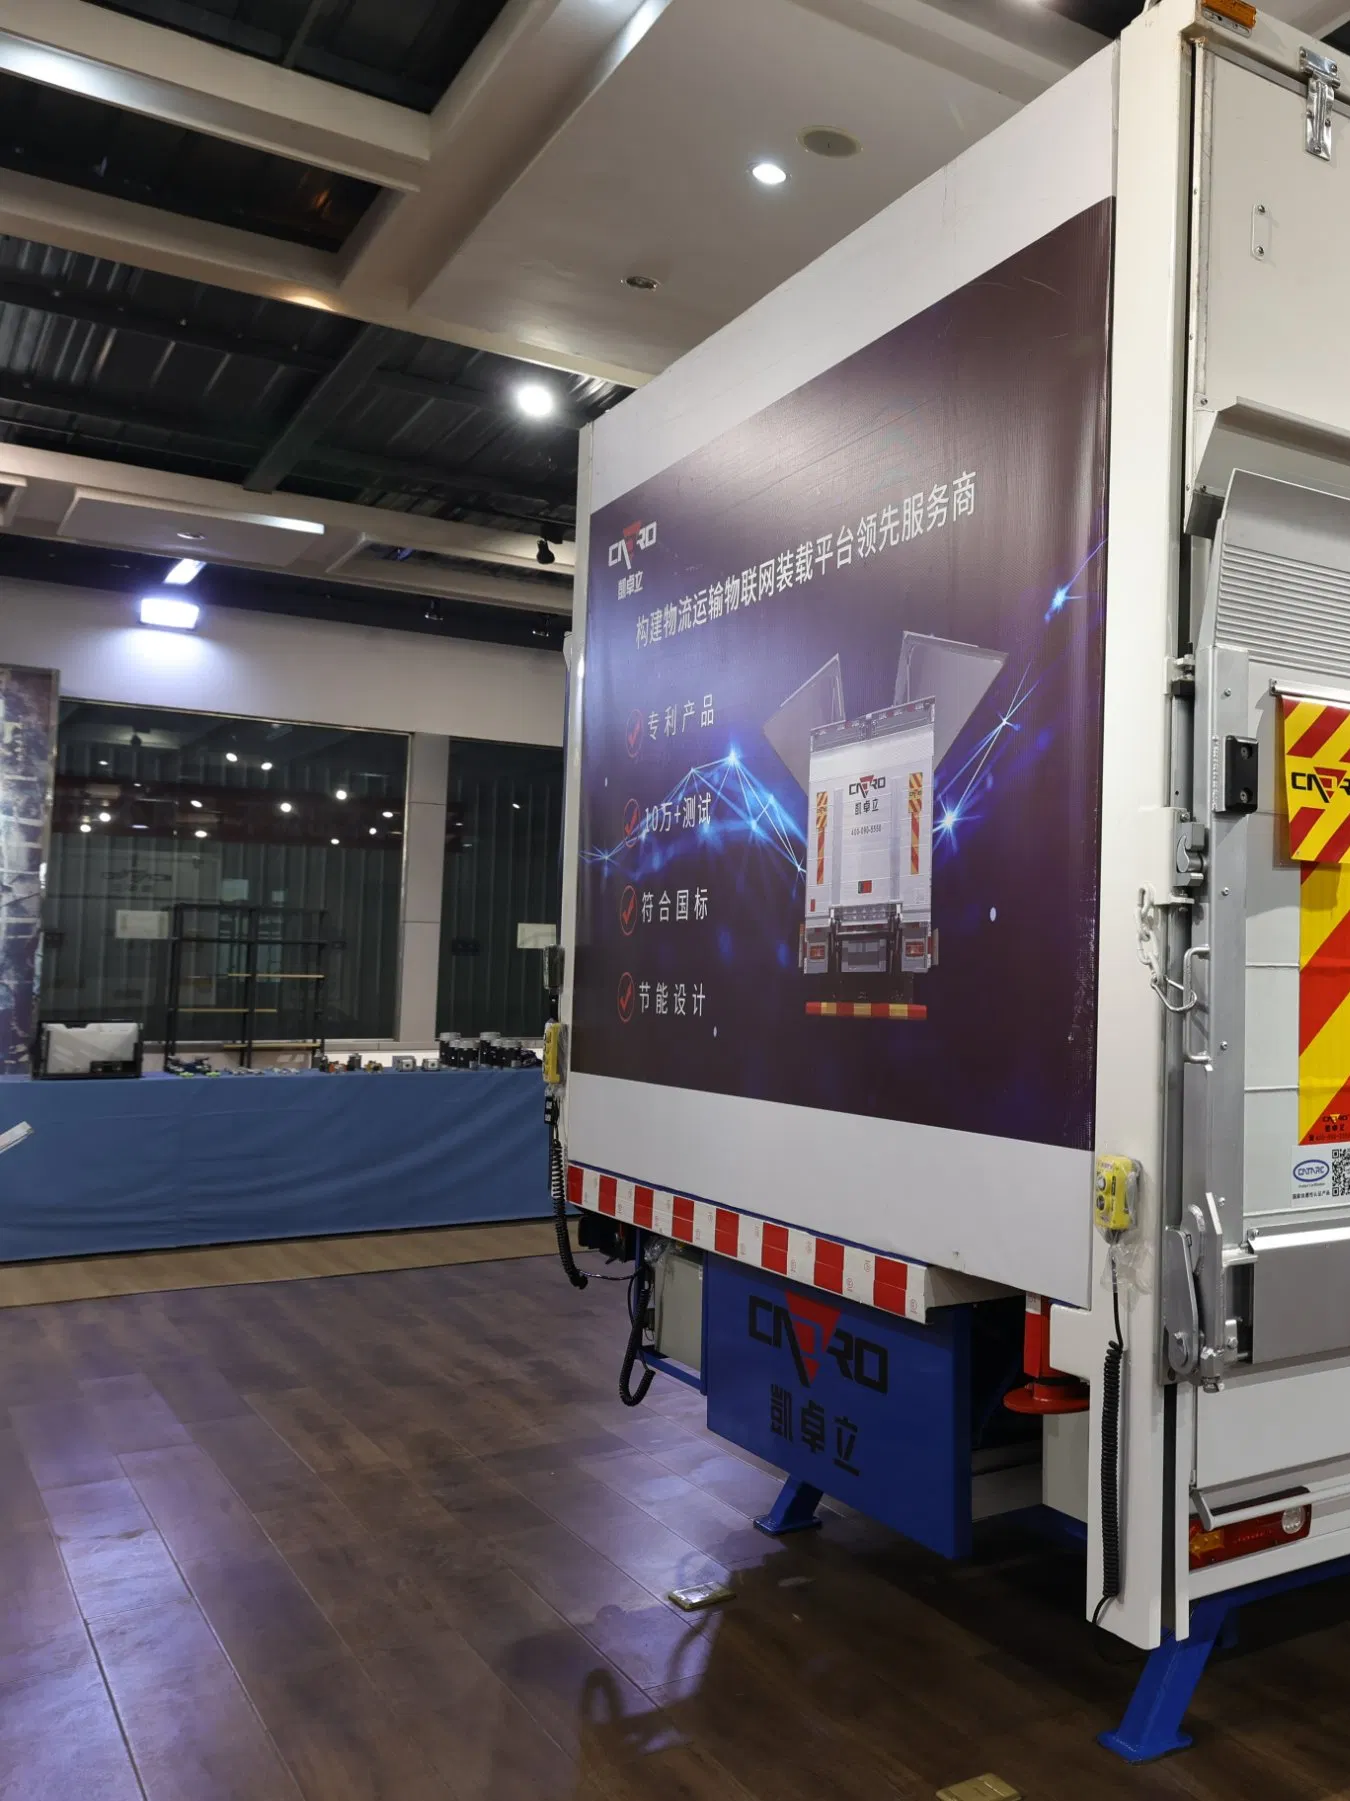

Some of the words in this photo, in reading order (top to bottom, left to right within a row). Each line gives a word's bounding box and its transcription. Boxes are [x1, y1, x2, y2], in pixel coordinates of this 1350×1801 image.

[635, 470, 978, 650] 构建物流运输物联网装载平台领先服务商
[648, 693, 714, 740] 专利产品
[644, 792, 711, 833] 10万+测试
[641, 886, 708, 923] 符合国标
[639, 981, 706, 1017] 节能设计
